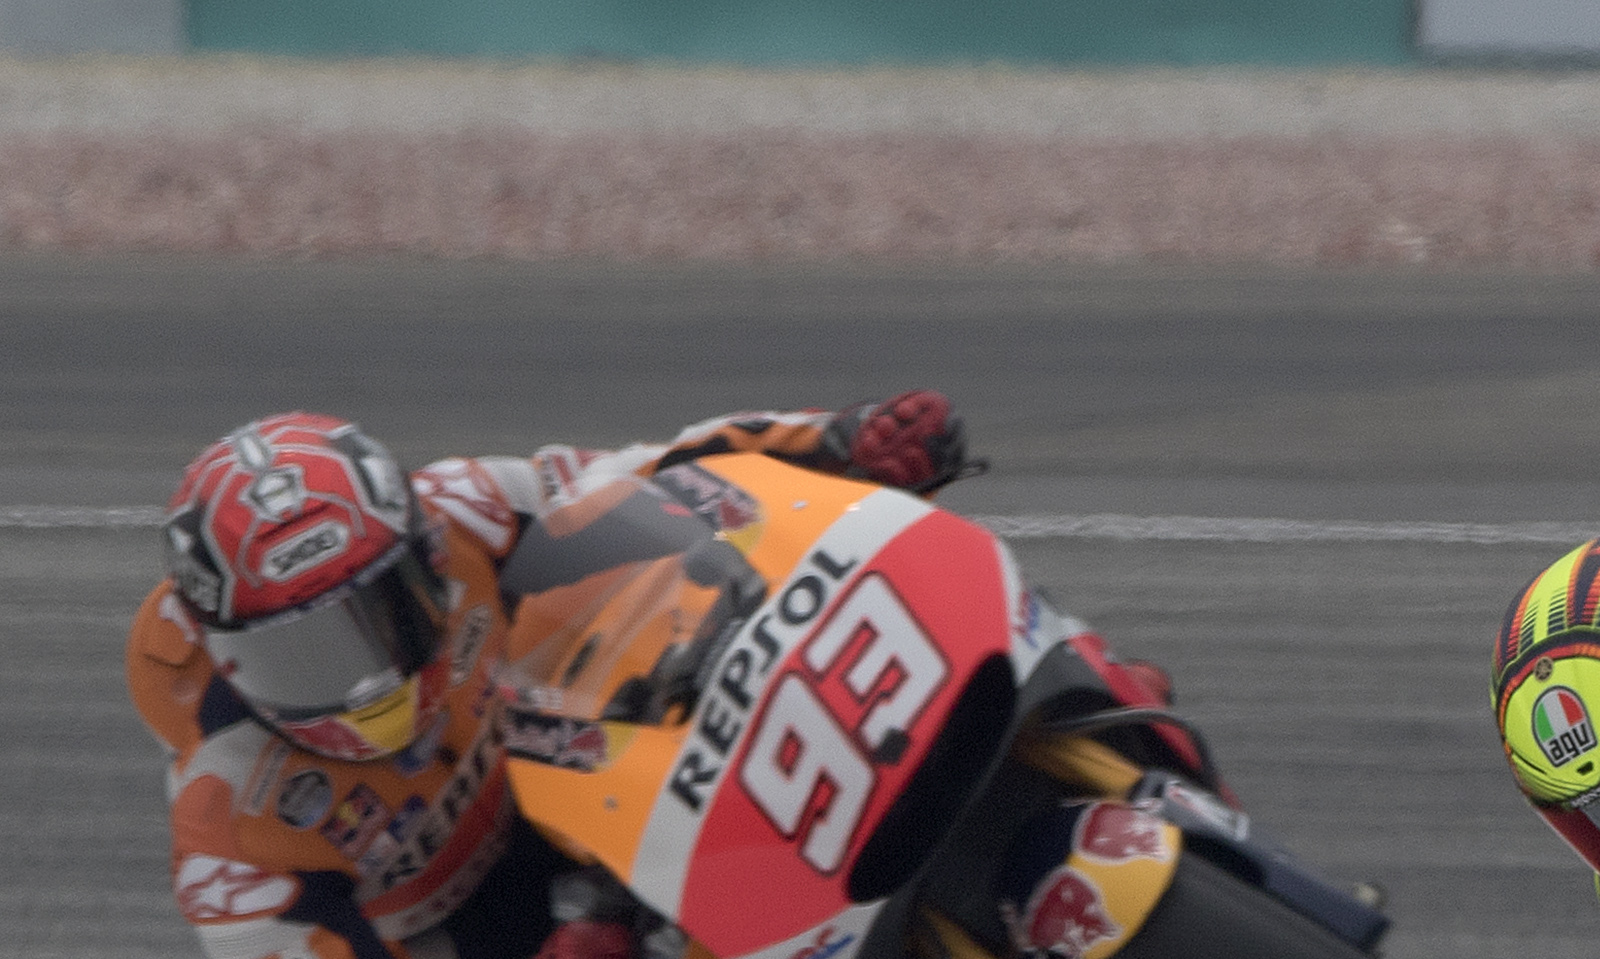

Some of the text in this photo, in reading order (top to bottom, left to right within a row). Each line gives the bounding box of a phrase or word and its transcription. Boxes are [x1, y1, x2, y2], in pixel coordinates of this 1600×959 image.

[667, 547, 858, 813] REPSOL
[738, 568, 953, 876] 93
[1548, 722, 1591, 761] agv
